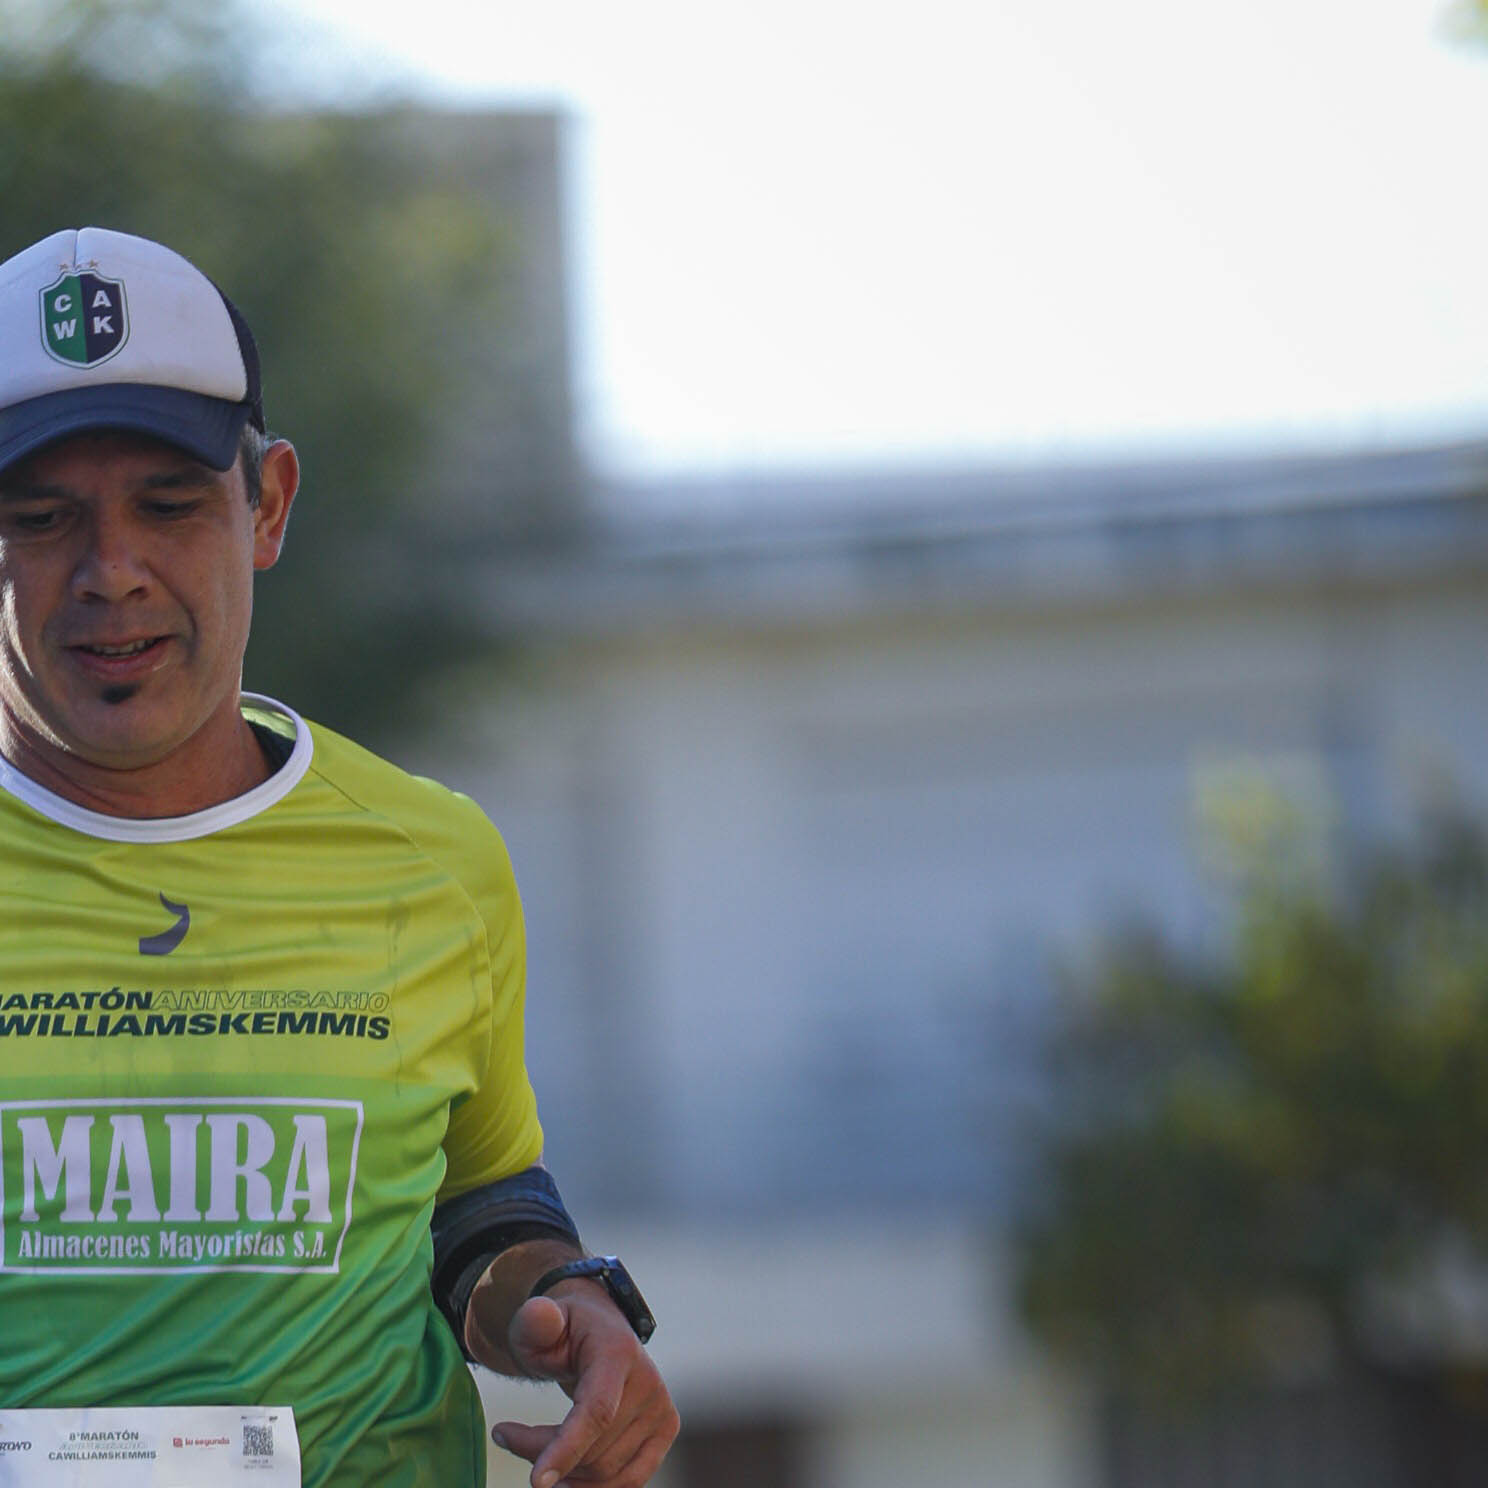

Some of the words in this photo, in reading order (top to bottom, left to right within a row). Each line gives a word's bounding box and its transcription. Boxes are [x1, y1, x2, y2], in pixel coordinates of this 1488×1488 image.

[17, 1113, 333, 1223] MAIRA
[18, 1231, 150, 1259] Almacenes
[159, 1231, 285, 1261] Mayoristas
